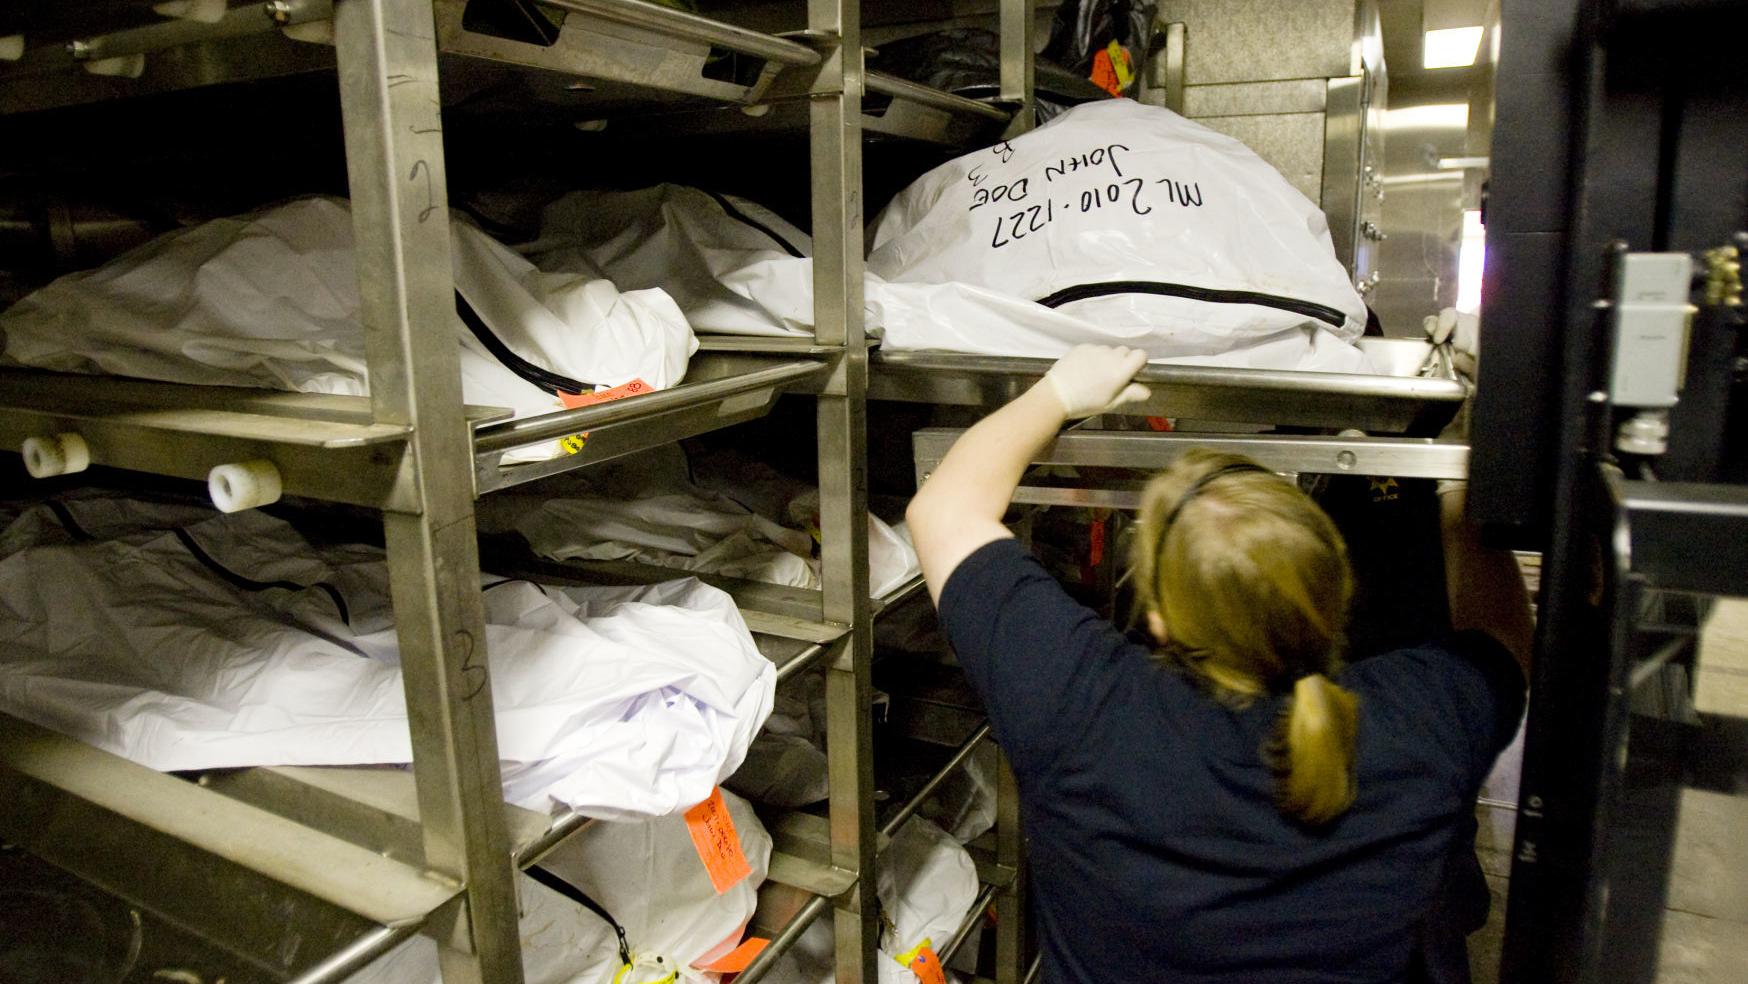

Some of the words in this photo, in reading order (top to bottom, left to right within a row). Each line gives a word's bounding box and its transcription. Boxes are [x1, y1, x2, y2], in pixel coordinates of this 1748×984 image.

[968, 163, 988, 187] 3
[1046, 144, 1130, 181] JOHN
[410, 160, 439, 224] 2
[968, 178, 1029, 211] DOE
[1156, 178, 1203, 206] ML
[455, 629, 487, 701] 3
